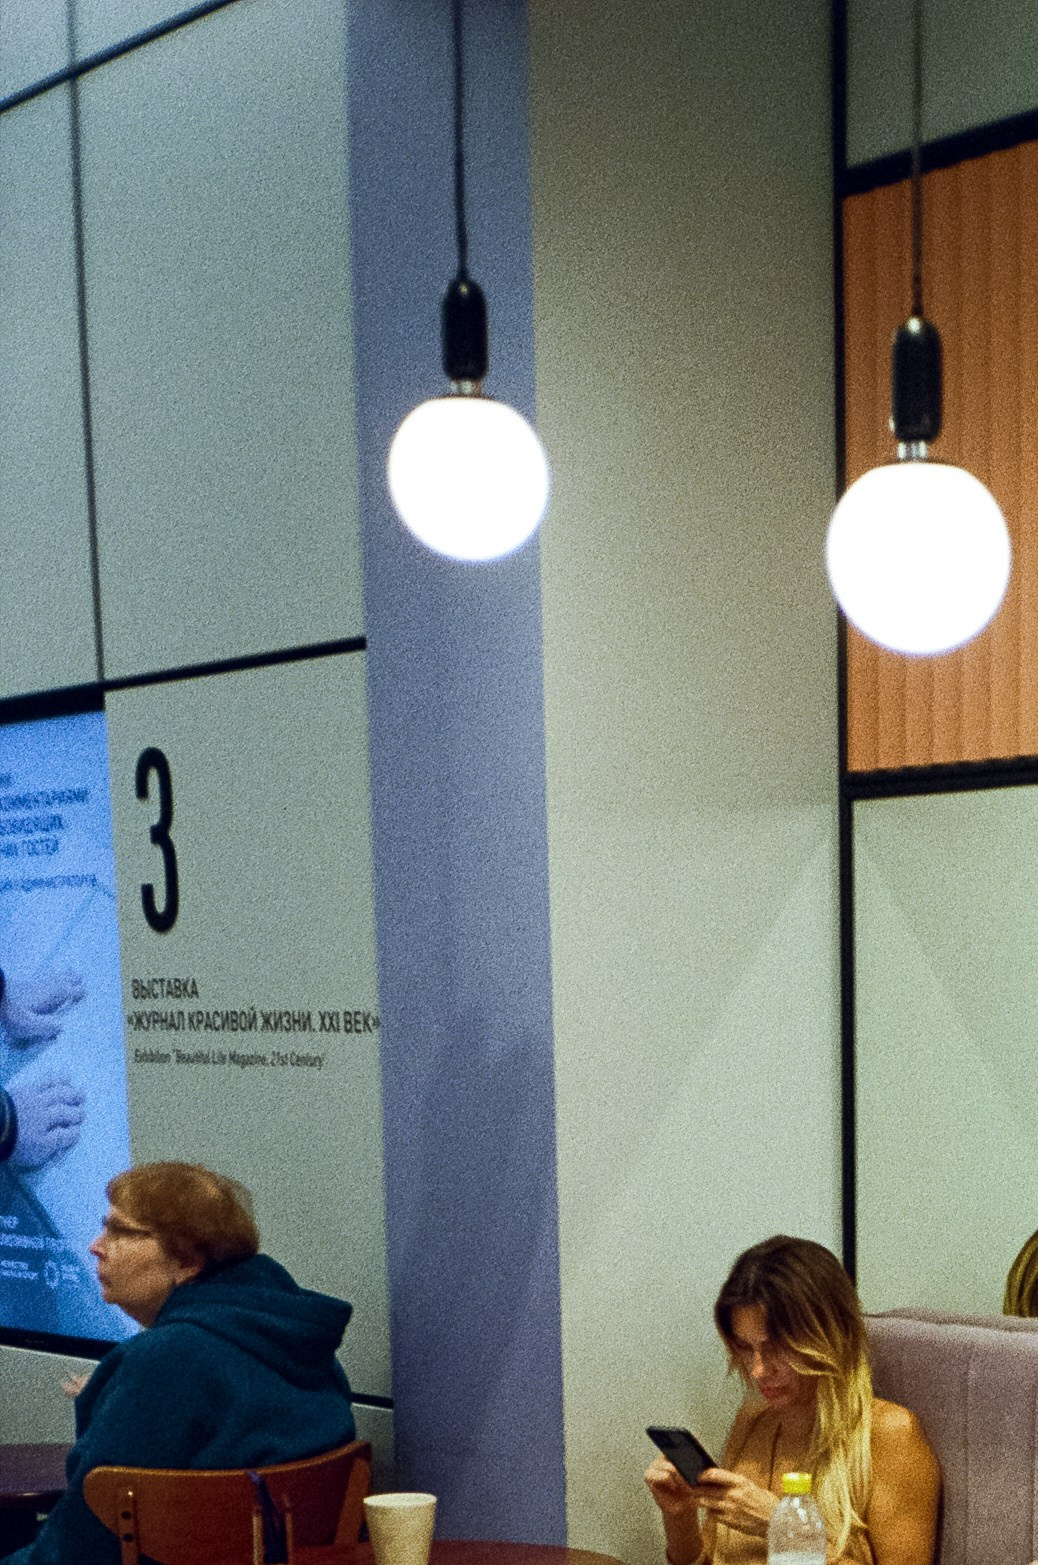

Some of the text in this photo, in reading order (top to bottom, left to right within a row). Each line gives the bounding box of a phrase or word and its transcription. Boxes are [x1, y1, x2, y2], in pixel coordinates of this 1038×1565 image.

[136, 747, 179, 934] 3
[131, 977, 200, 1000] ВЫСТАВКА
[127, 1006, 381, 1034] «ЖУРНАЛ КРАСИВОЙ ЖИЗНИ. XXI ВЕК»
